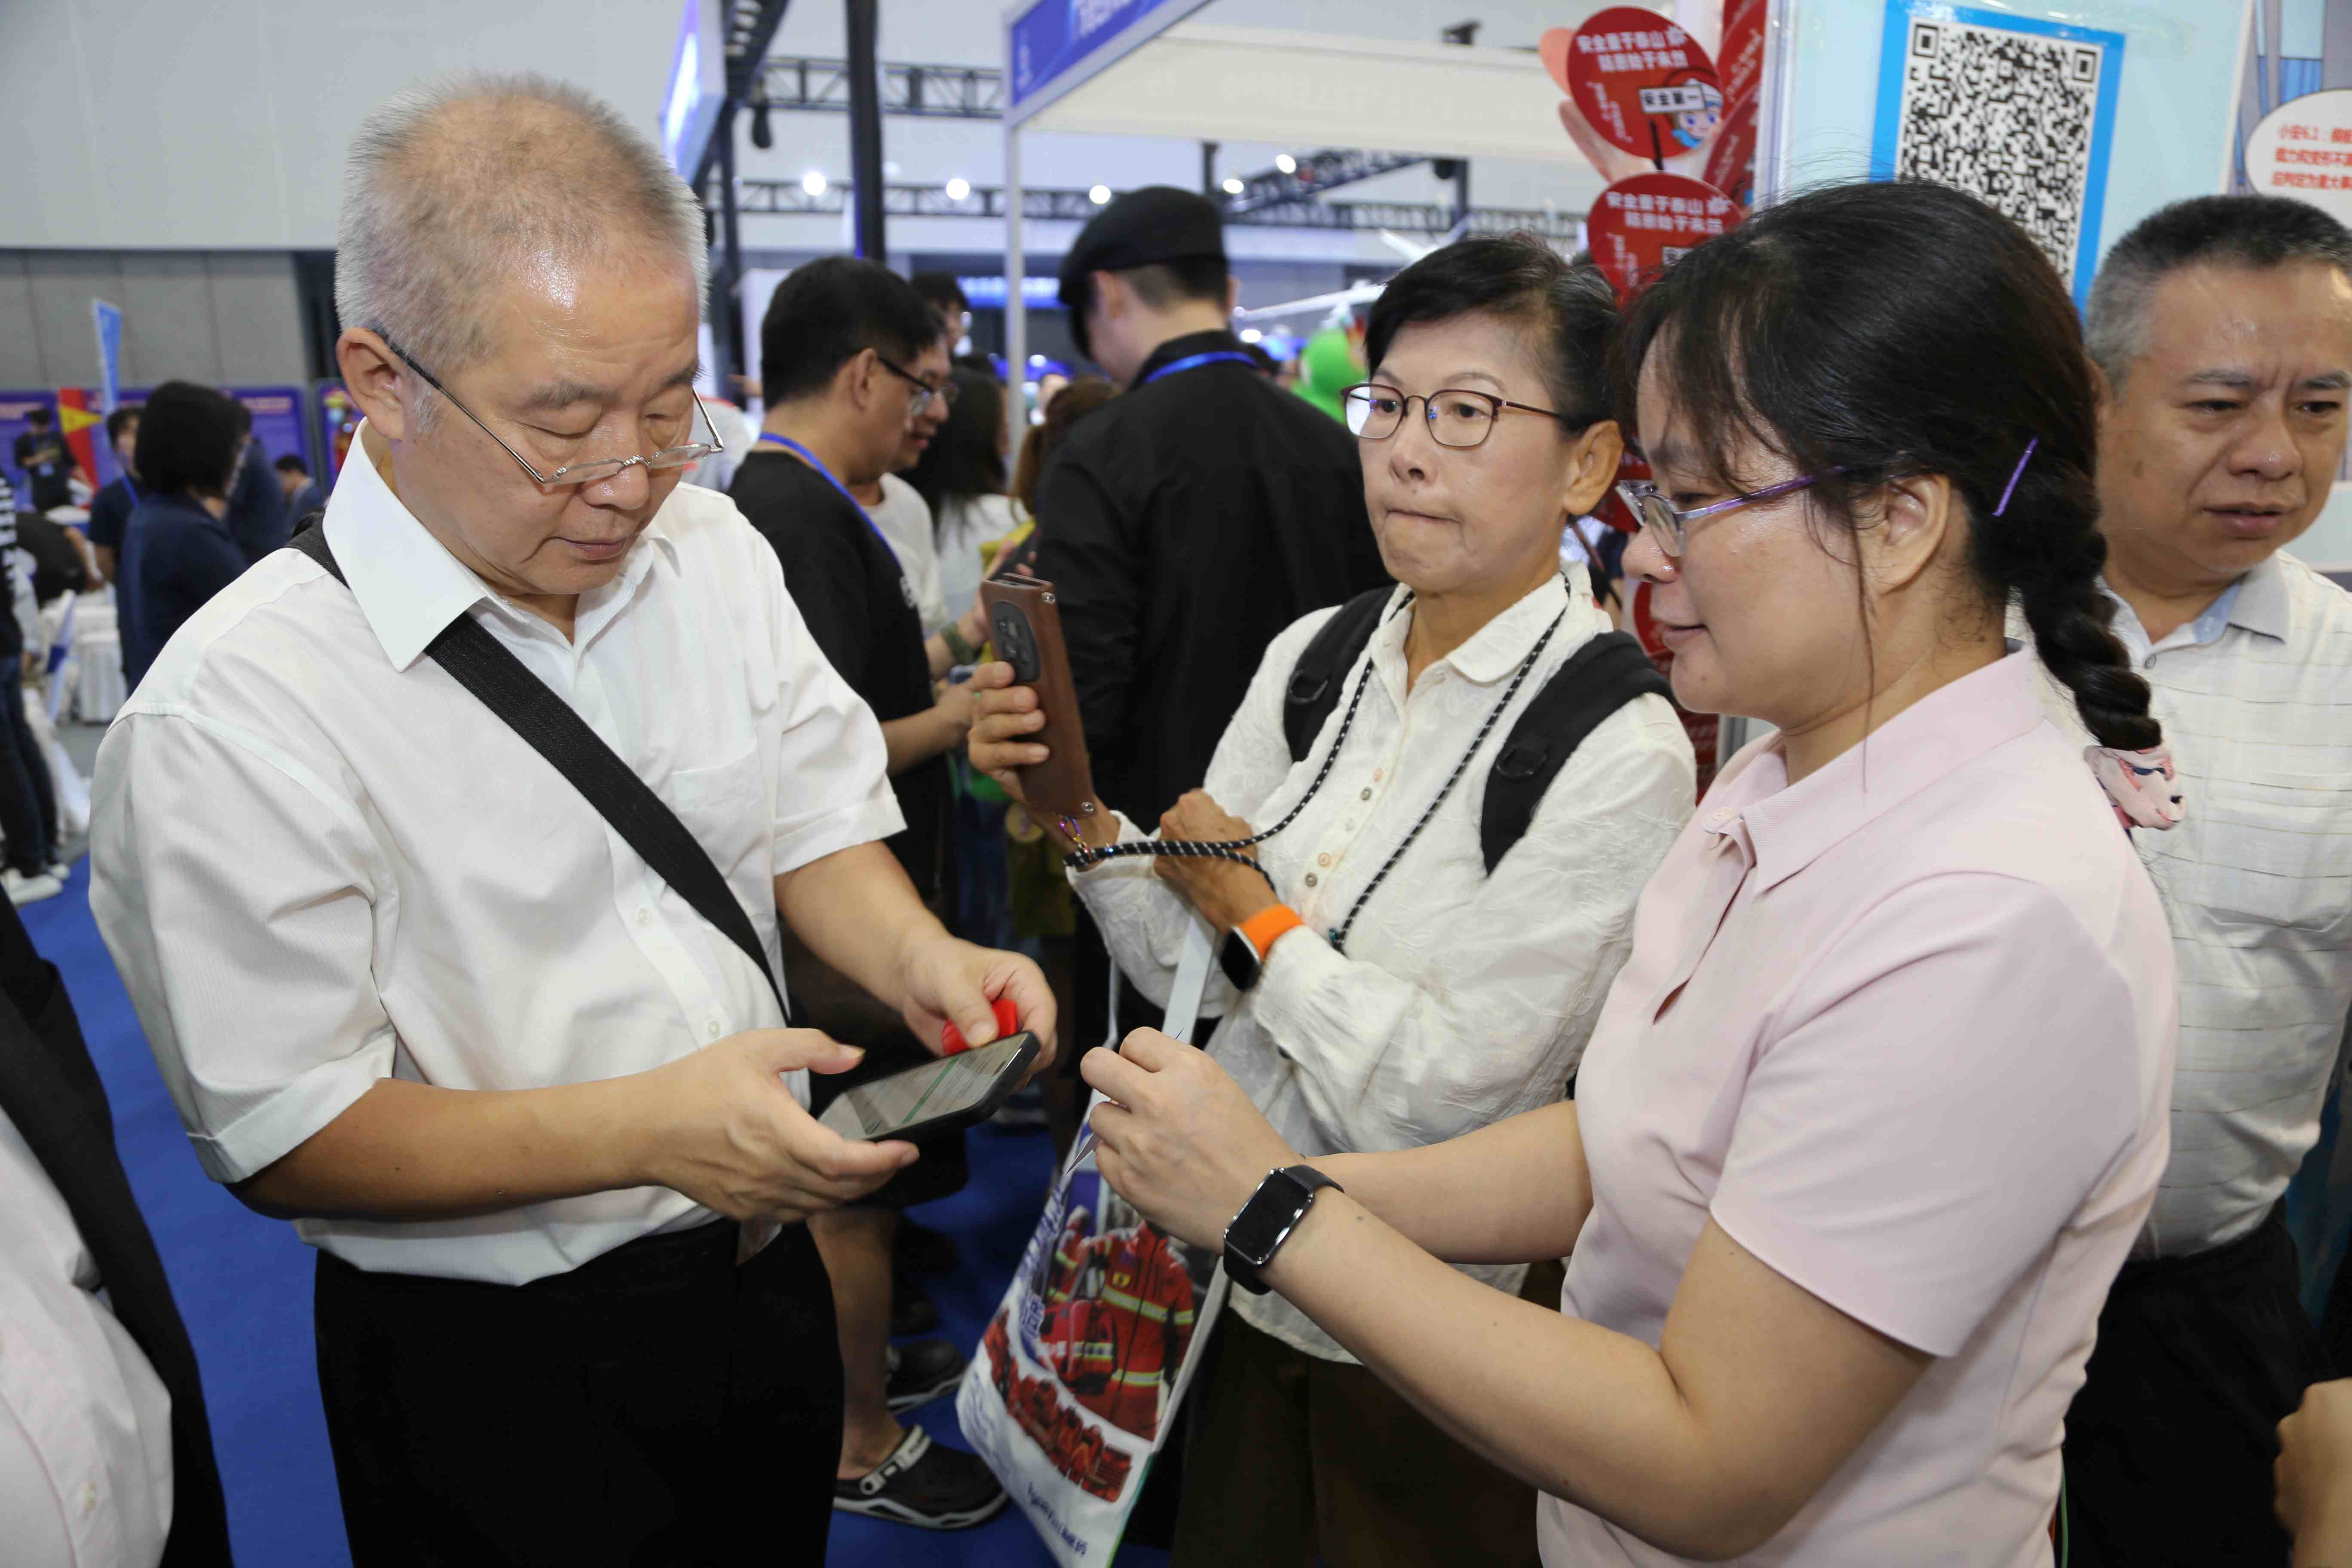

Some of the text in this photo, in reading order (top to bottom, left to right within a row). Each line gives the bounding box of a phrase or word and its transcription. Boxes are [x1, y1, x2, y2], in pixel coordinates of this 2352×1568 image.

[1577, 30, 1666, 53] 安全重于泰山
[1644, 90, 1699, 105] 安全第一
[1606, 191, 1703, 215] 安全重于泰山
